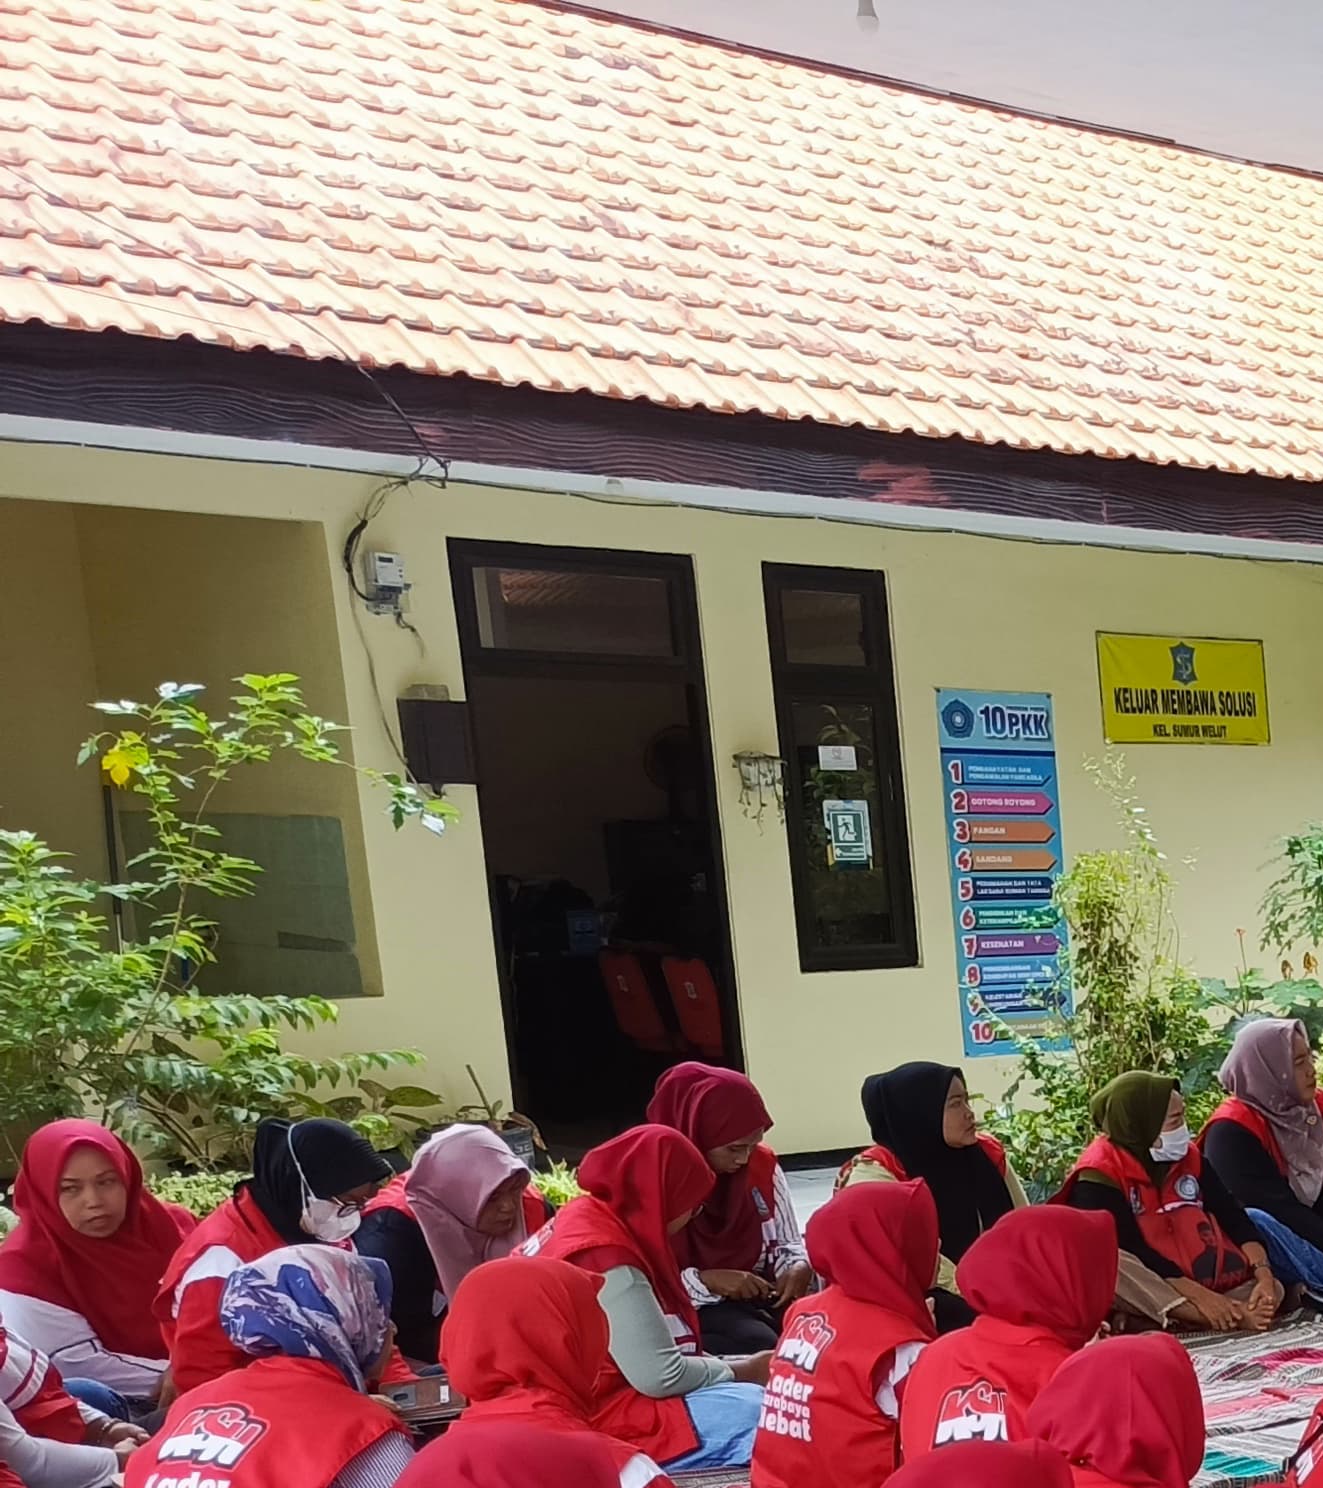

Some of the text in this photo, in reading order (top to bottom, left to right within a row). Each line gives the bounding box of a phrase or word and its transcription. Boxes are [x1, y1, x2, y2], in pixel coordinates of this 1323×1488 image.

[1114, 688, 1256, 717] KELUAR MEMBAWA SOLUSI
[1008, 713, 1047, 737] PKK
[1153, 724, 1226, 738] KEL. SUMUR WELUT
[950, 761, 961, 783] 1
[952, 790, 968, 812] 2
[954, 820, 969, 842] 3
[955, 849, 971, 871] 4
[959, 878, 972, 900] 5
[960, 907, 975, 929] 6
[962, 935, 976, 957] 7
[966, 964, 981, 986] 8
[971, 1023, 994, 1042] 10
[768, 1369, 813, 1403] ader
[763, 1395, 810, 1418] urabaya
